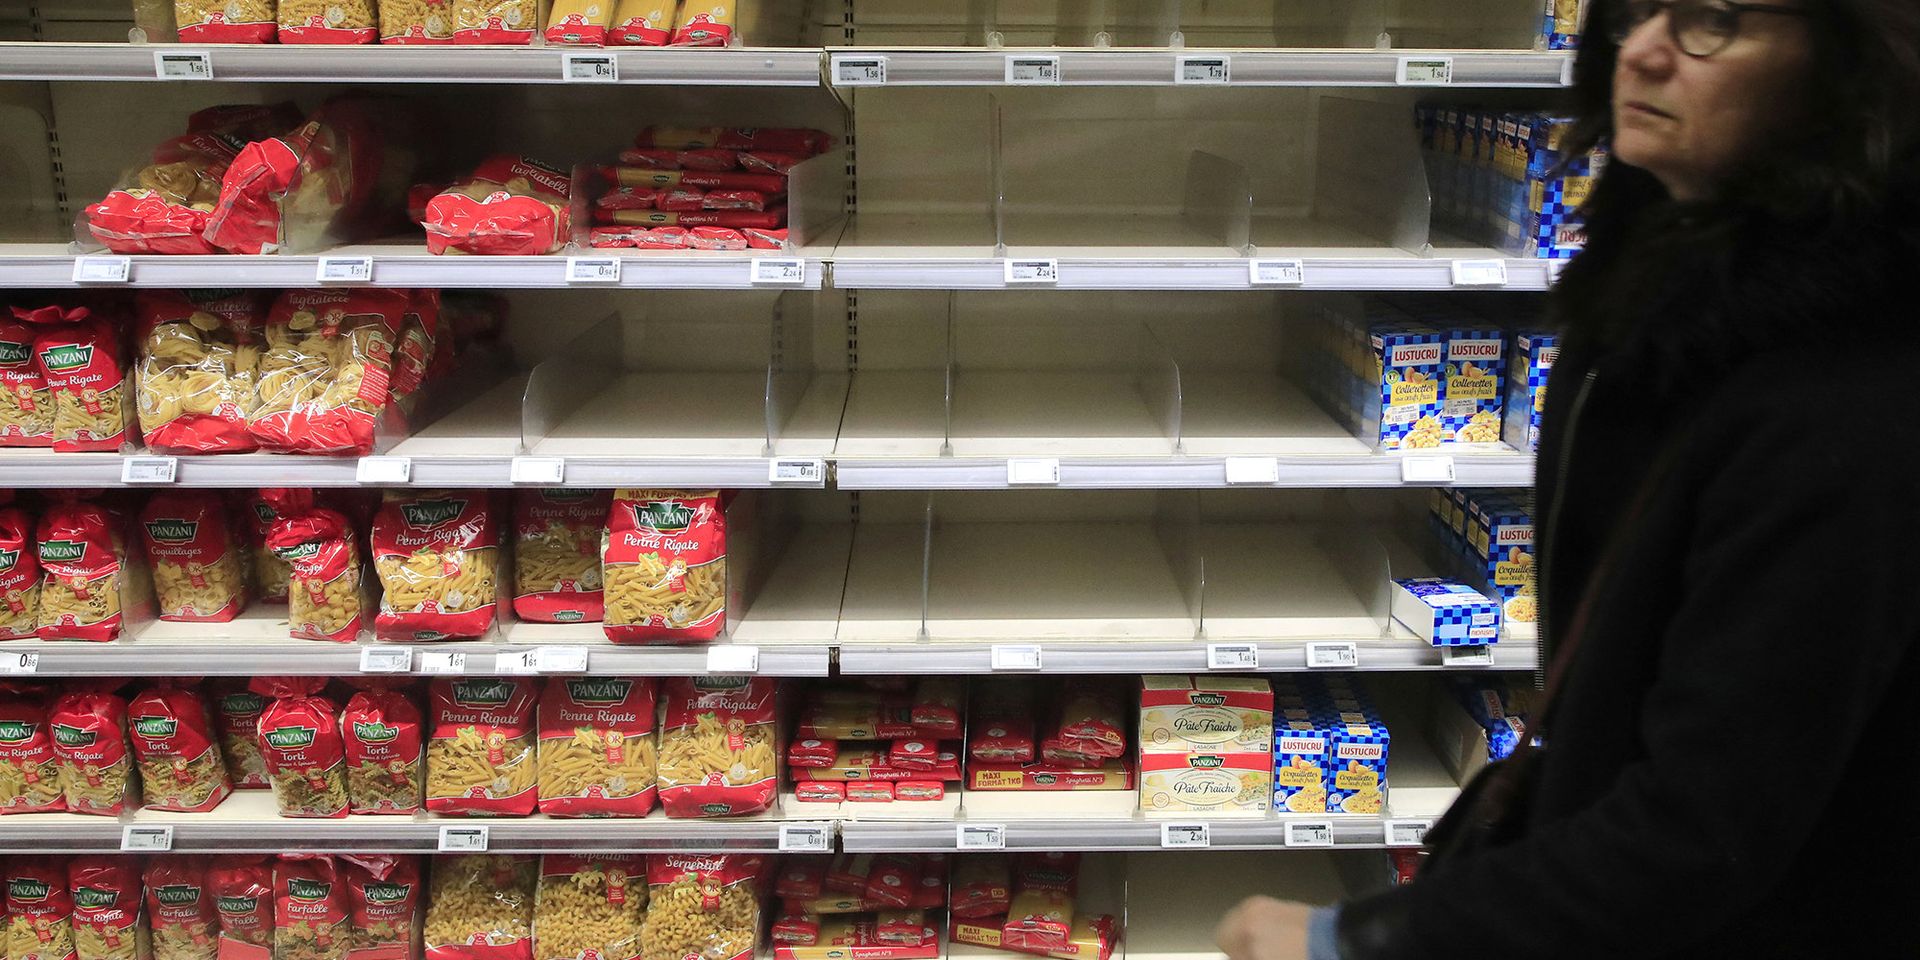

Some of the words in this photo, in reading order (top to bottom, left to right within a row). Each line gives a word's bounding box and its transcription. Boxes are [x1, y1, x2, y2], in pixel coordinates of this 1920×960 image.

[1394, 349, 1438, 361] LUSTUCRU
[1451, 345, 1498, 356] LUSTUCRU
[45, 351, 88, 367] PANZANI
[69, 374, 103, 388] Rigate
[409, 504, 458, 521] PANZANI
[640, 511, 688, 525] PANZANI
[151, 525, 193, 537] PANZANI
[1500, 530, 1533, 540] LUSTUC
[624, 533, 660, 550] Penne
[663, 537, 699, 554] Rigate
[40, 546, 81, 557] PANZANI
[151, 546, 202, 559] Coquillages
[457, 685, 508, 700] PANZANI
[573, 684, 624, 698] PANZANI
[720, 698, 758, 714] Rigate
[441, 710, 476, 723] Penne
[479, 712, 518, 728] Rigate
[559, 709, 593, 721] Penne
[597, 709, 636, 728] Rigate
[137, 721, 173, 733] PANZANI
[1173, 717, 1200, 731] Pâte
[1199, 718, 1237, 733] Fraîche
[55, 729, 92, 742] PANZANI
[270, 732, 311, 744] PANZANI
[356, 726, 397, 738] PANZANI
[147, 741, 170, 751] Torti
[364, 745, 390, 755] Torti
[1283, 741, 1322, 751] LUSTUCRU
[1340, 747, 1380, 756] LUSTUCRU
[11, 746, 43, 759] Rigate
[74, 752, 104, 763] Rigate
[280, 752, 307, 761] Torti
[873, 771, 900, 779] Spaghetti
[1066, 776, 1091, 784] Spaghetti
[978, 778, 1006, 788] FORMAT
[1007, 777, 1022, 785] 1KG
[1173, 781, 1199, 794] Pâte
[1199, 781, 1236, 795] Fraîche
[10, 885, 46, 896] PANZANI
[157, 890, 196, 901] PANZANI
[290, 885, 326, 896] PANZANI
[368, 887, 408, 899] PANZANI
[74, 892, 113, 905] PANZANI
[27, 905, 56, 916] Rigate
[218, 900, 254, 911] PANZANI
[287, 902, 328, 914] Farfalle
[366, 904, 407, 915] Farfalle
[93, 911, 124, 924] Rigate
[222, 916, 259, 925] Farfalle
[959, 933, 985, 942] FORMAT
